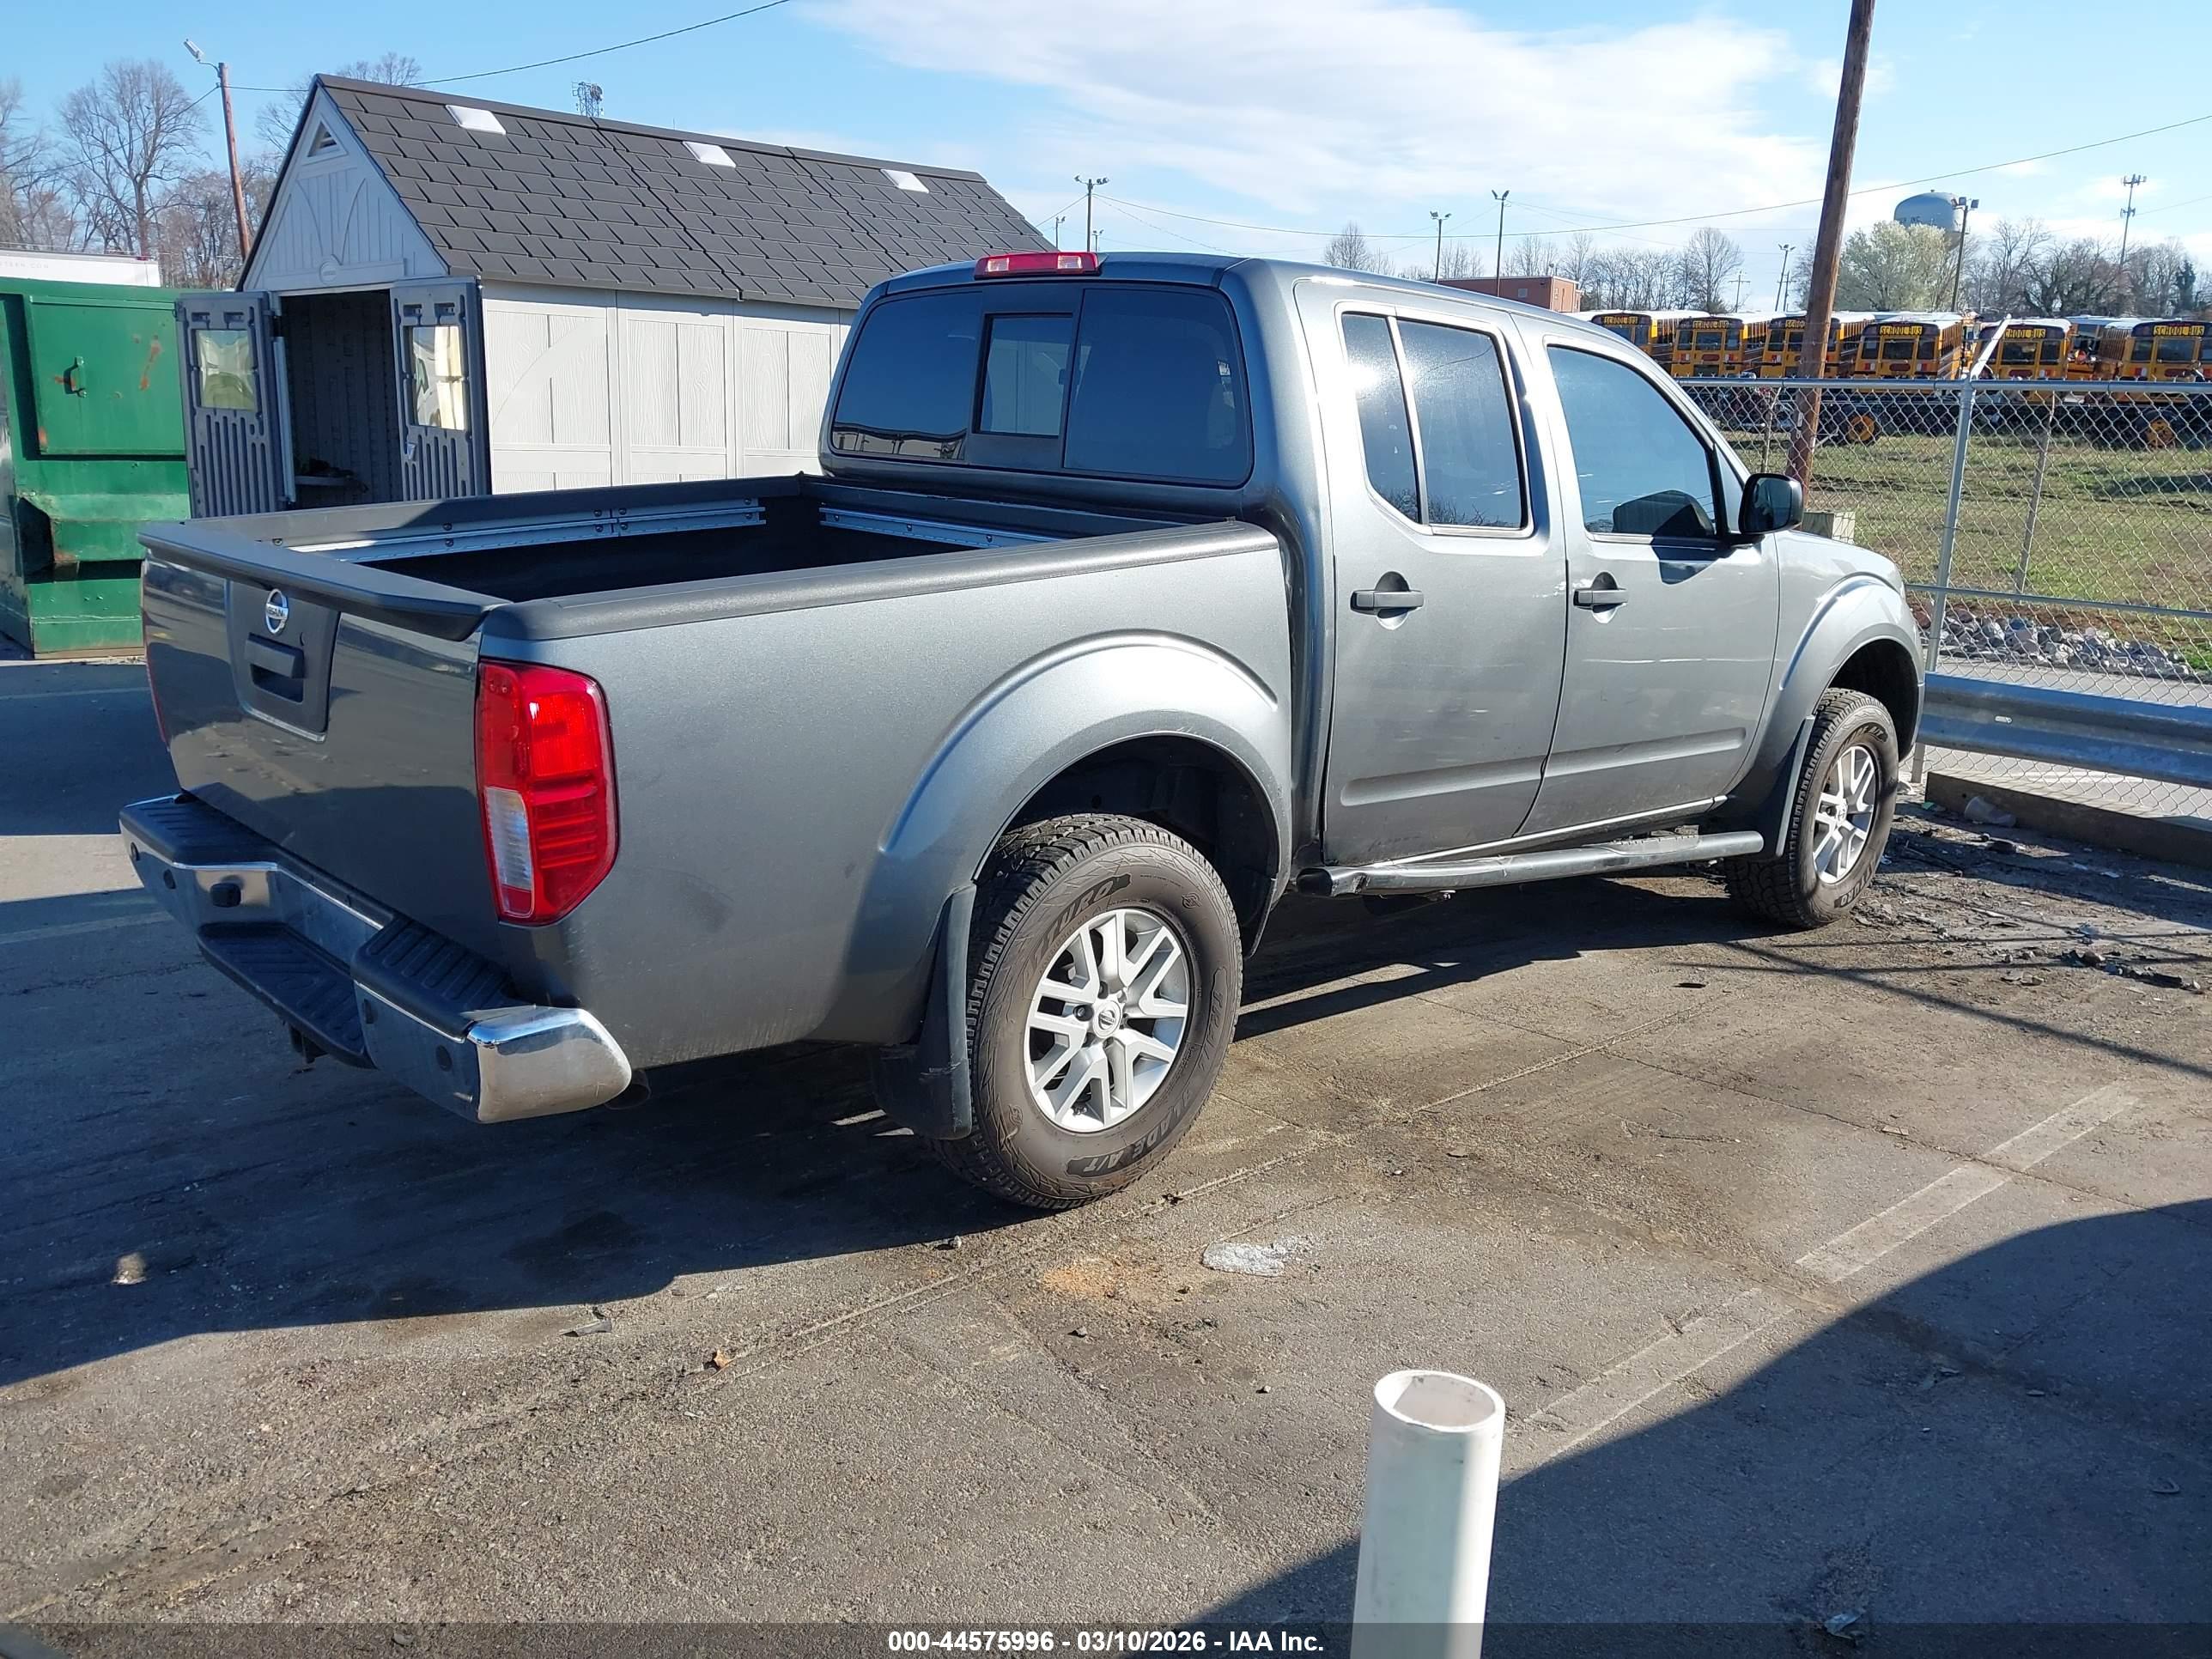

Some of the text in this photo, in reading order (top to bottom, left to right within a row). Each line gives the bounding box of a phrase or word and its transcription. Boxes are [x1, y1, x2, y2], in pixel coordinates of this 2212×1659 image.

[2155, 326, 2204, 336] SCHOOL BUS
[1083, 1151, 1125, 1173] A/T
